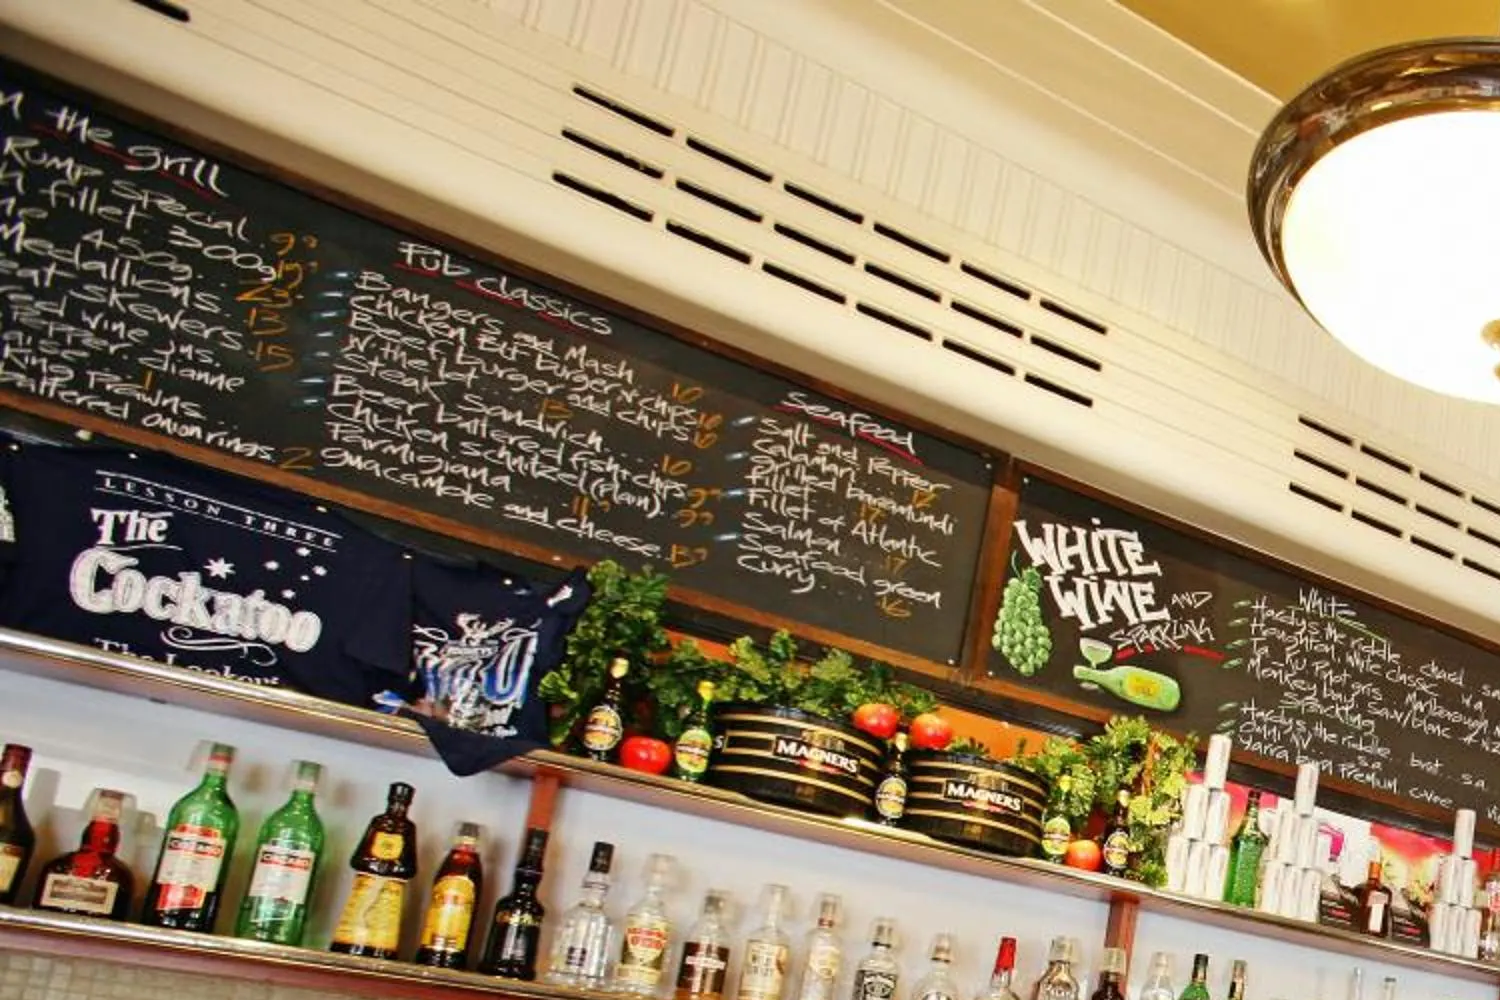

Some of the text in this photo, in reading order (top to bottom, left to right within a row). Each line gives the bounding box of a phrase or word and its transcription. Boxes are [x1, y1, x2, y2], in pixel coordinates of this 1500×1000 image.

[91, 507, 174, 545] The
[69, 547, 322, 653] Cockatoo
[776, 738, 858, 774] MAGNERS
[947, 782, 1021, 812] MAGNERS
